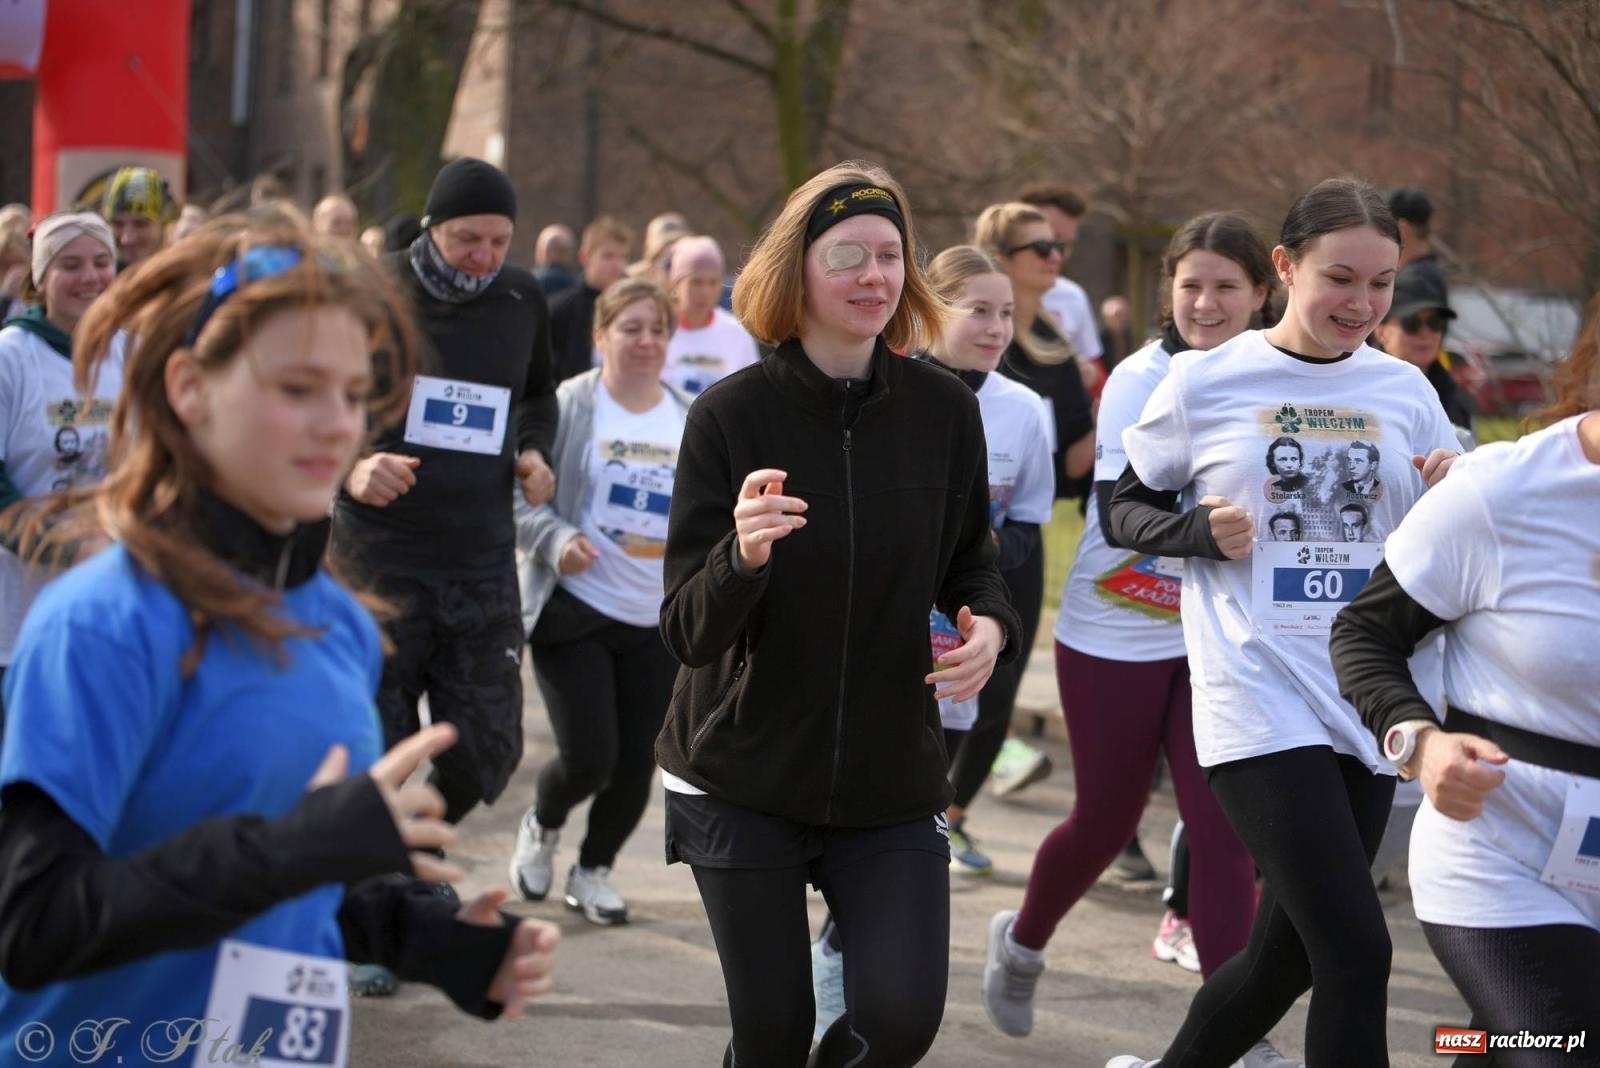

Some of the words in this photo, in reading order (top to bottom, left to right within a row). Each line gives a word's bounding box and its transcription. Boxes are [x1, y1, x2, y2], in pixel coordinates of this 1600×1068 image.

[452, 403, 468, 425] 9
[1304, 408, 1335, 417] TROPEM
[1306, 417, 1366, 430] WILCZYM
[633, 490, 650, 511] 8
[1271, 491, 1306, 500] Stolarska
[1315, 553, 1350, 564] WILCZYM
[1303, 570, 1343, 599] 60
[278, 1006, 327, 1060] 83
